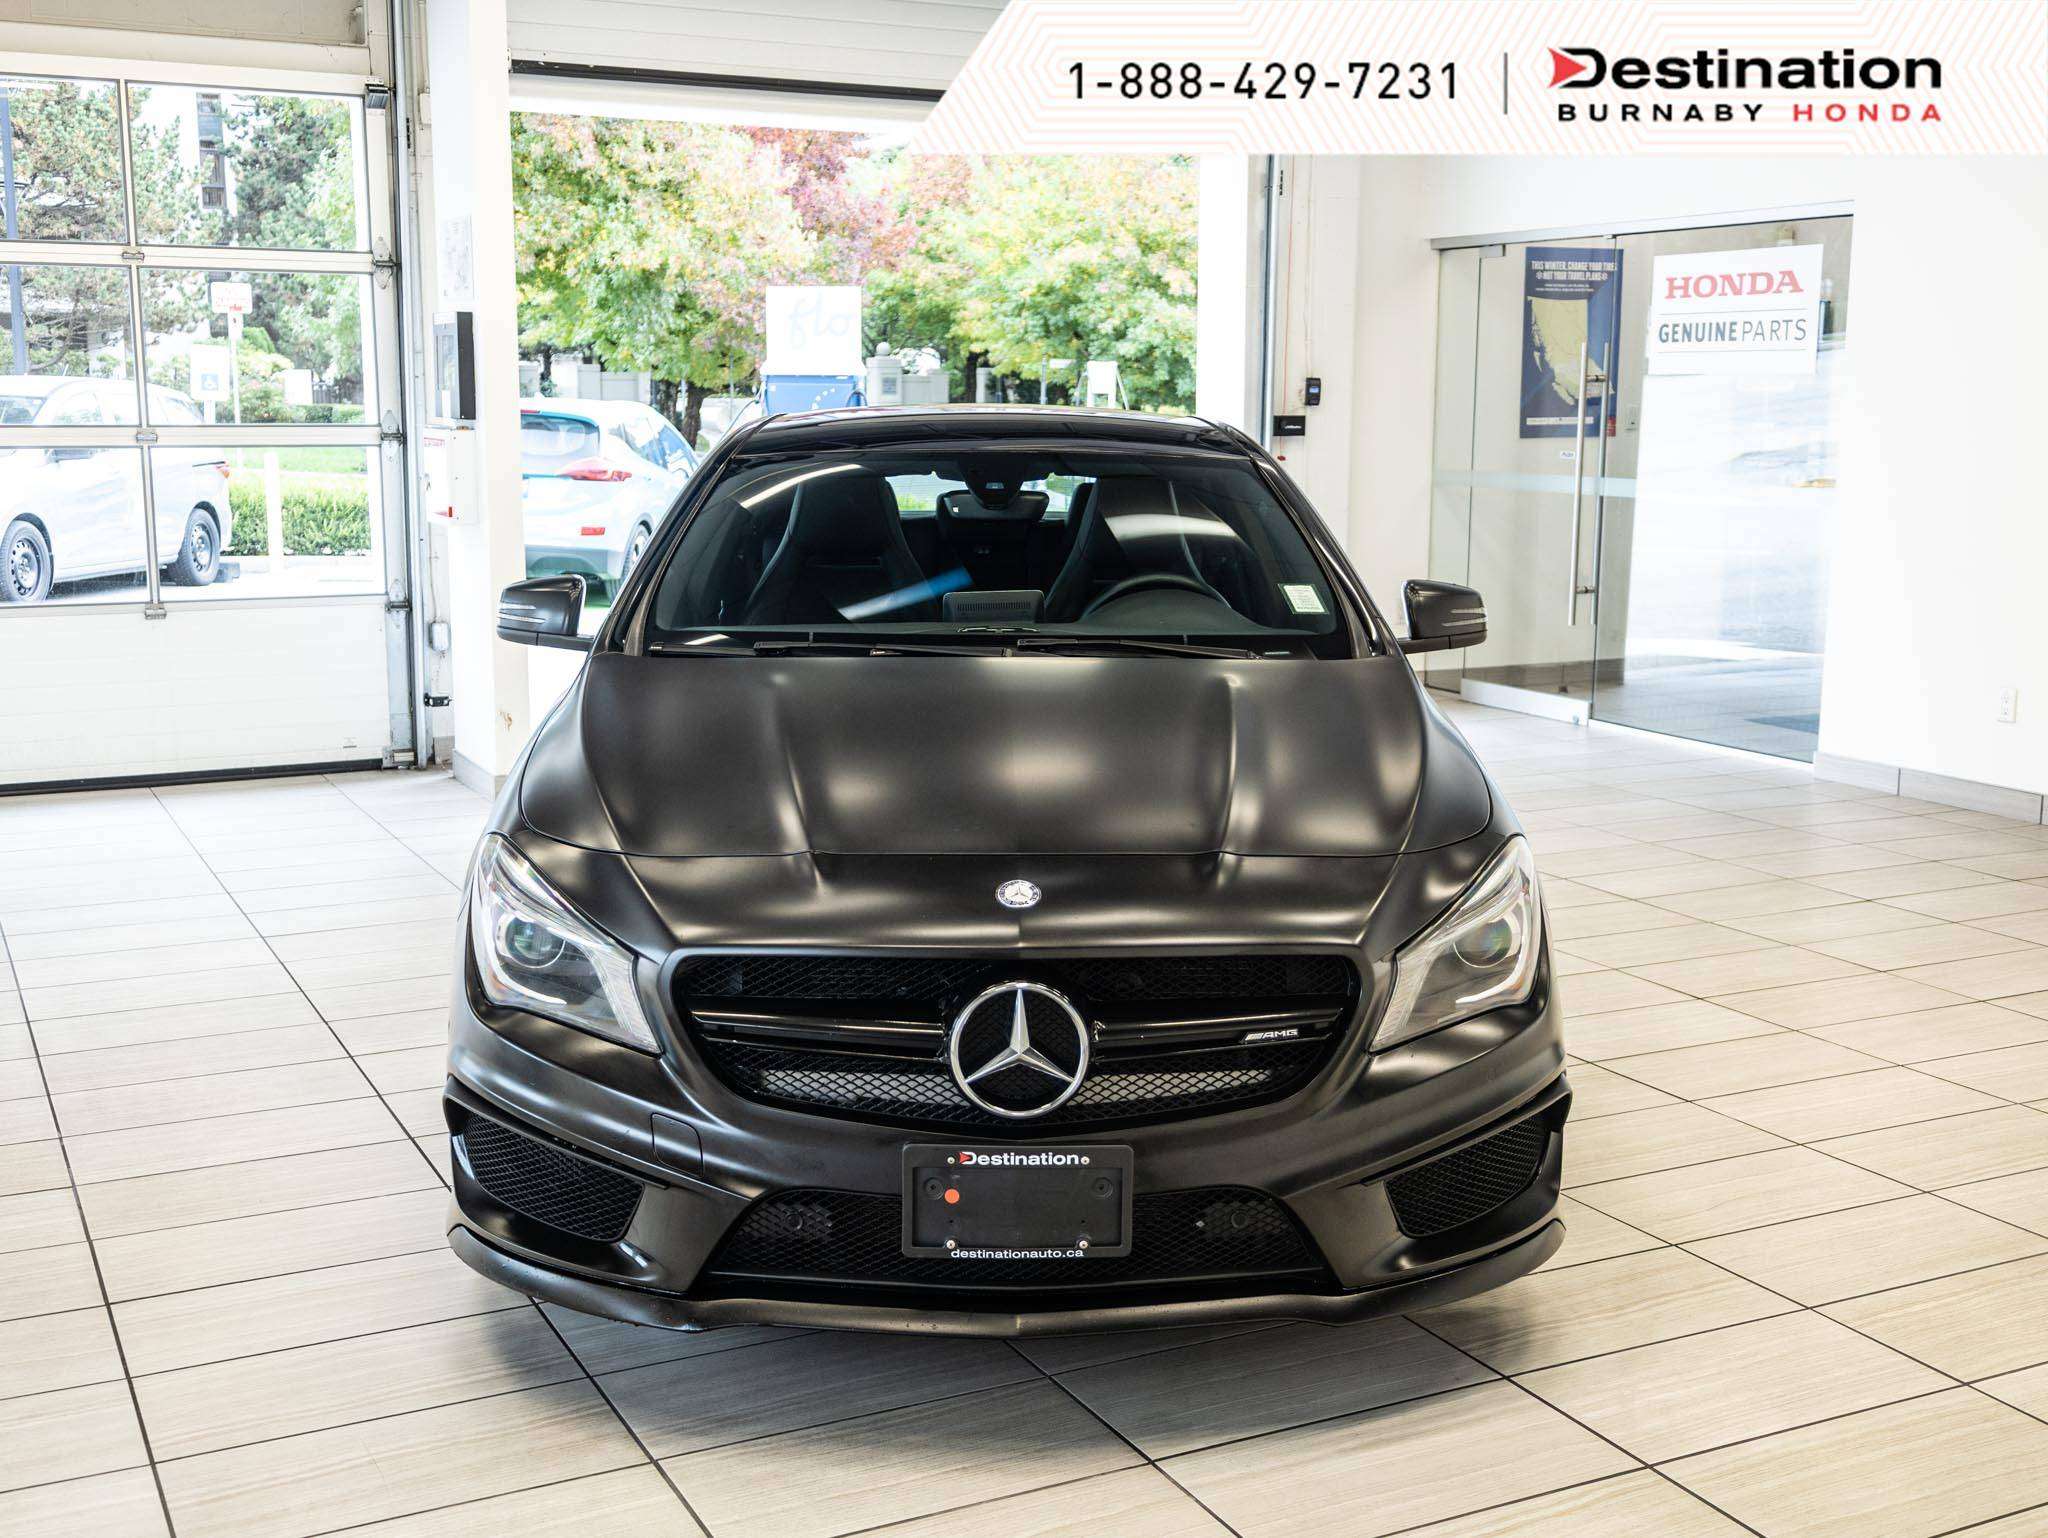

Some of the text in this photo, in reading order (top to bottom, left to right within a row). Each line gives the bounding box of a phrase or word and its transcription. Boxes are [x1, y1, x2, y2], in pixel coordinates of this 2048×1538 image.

[1665, 270, 1804, 299] HONDA
[1659, 318, 1806, 343] GENUINE PARTS
[1261, 1029, 1298, 1039] AMG
[959, 1151, 1079, 1166] Destination
[950, 1249, 1084, 1260] destinationauto.ca
